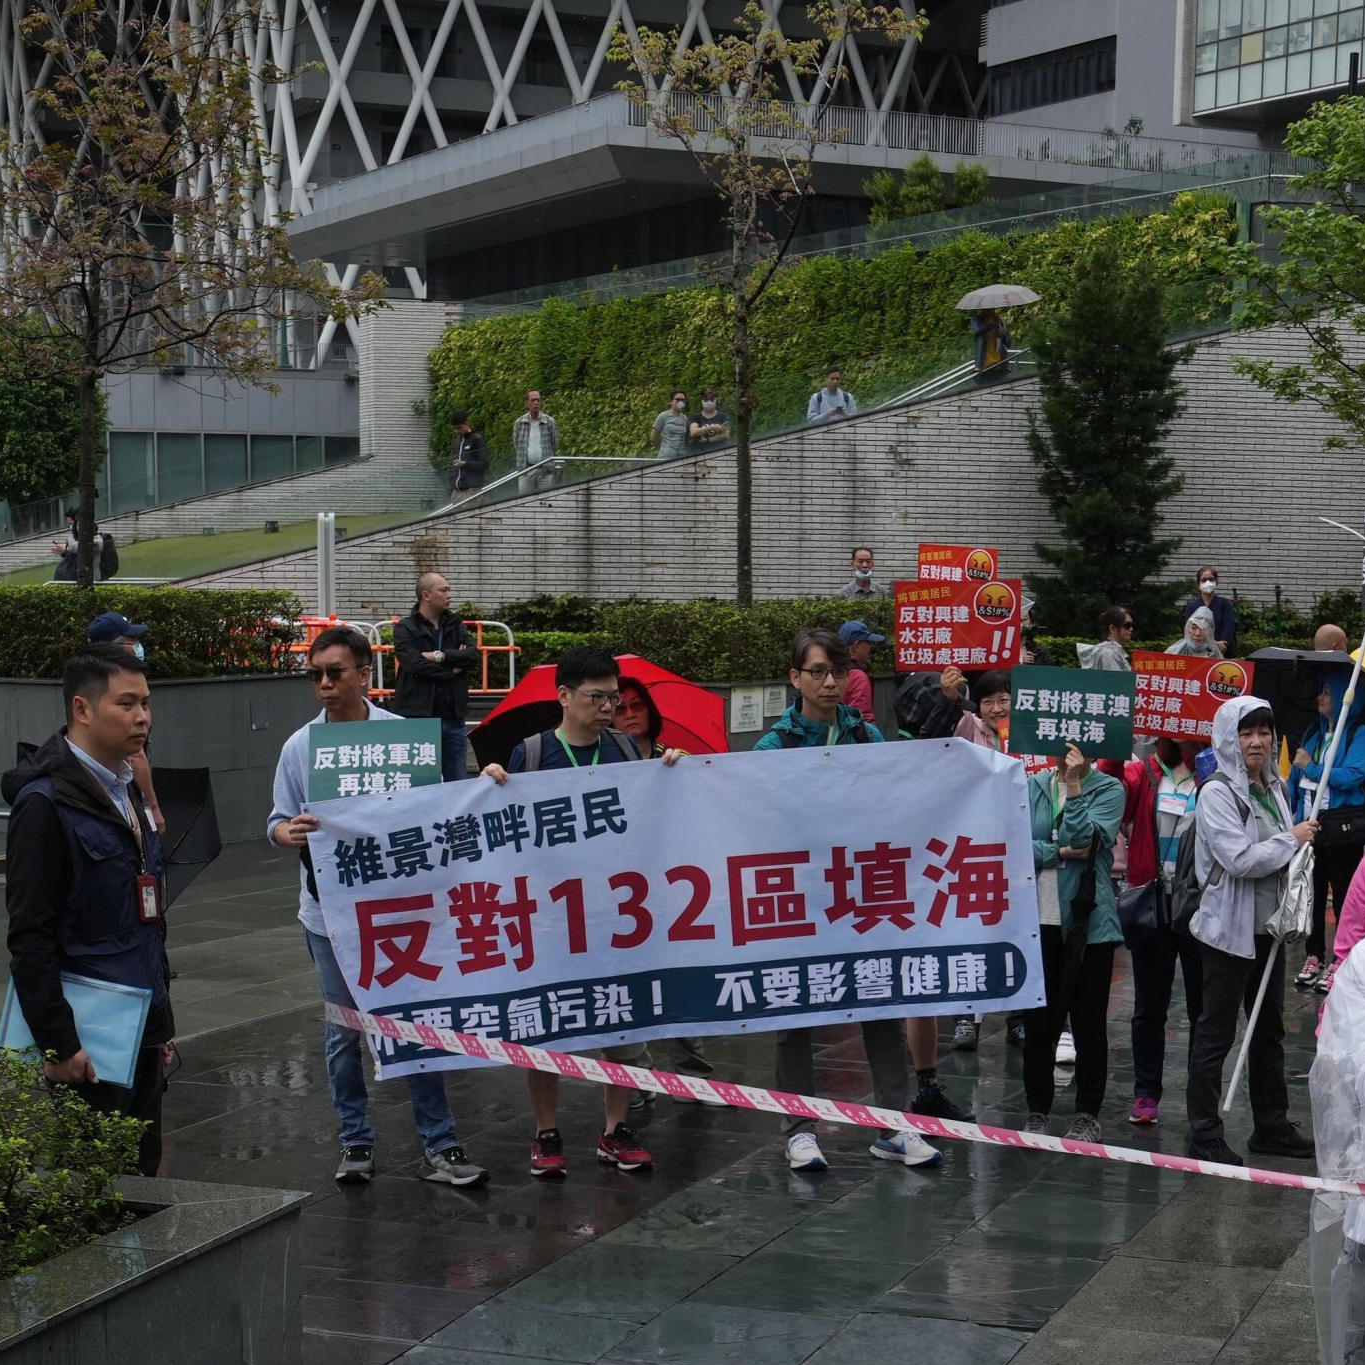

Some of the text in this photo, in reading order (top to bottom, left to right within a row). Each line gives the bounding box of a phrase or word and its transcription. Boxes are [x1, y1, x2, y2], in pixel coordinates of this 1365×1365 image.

[920, 564, 963, 581] 反對興建
[897, 586, 952, 604] 將軍澳居民
[899, 605, 970, 623] 反對興建
[899, 627, 952, 644] 水泥廠
[899, 647, 987, 664] 垃圾處理廠
[1135, 674, 1201, 696] 反對興建
[1014, 689, 1130, 717] 反對將軍澳
[1134, 693, 1183, 713] 水泥廠
[1035, 717, 1106, 744] 再填海
[314, 742, 437, 770] 反對將軍澳
[337, 771, 412, 797] 再填海
[335, 786, 629, 888] 維景灣畔居民
[356, 834, 1010, 991] 反對132區填海
